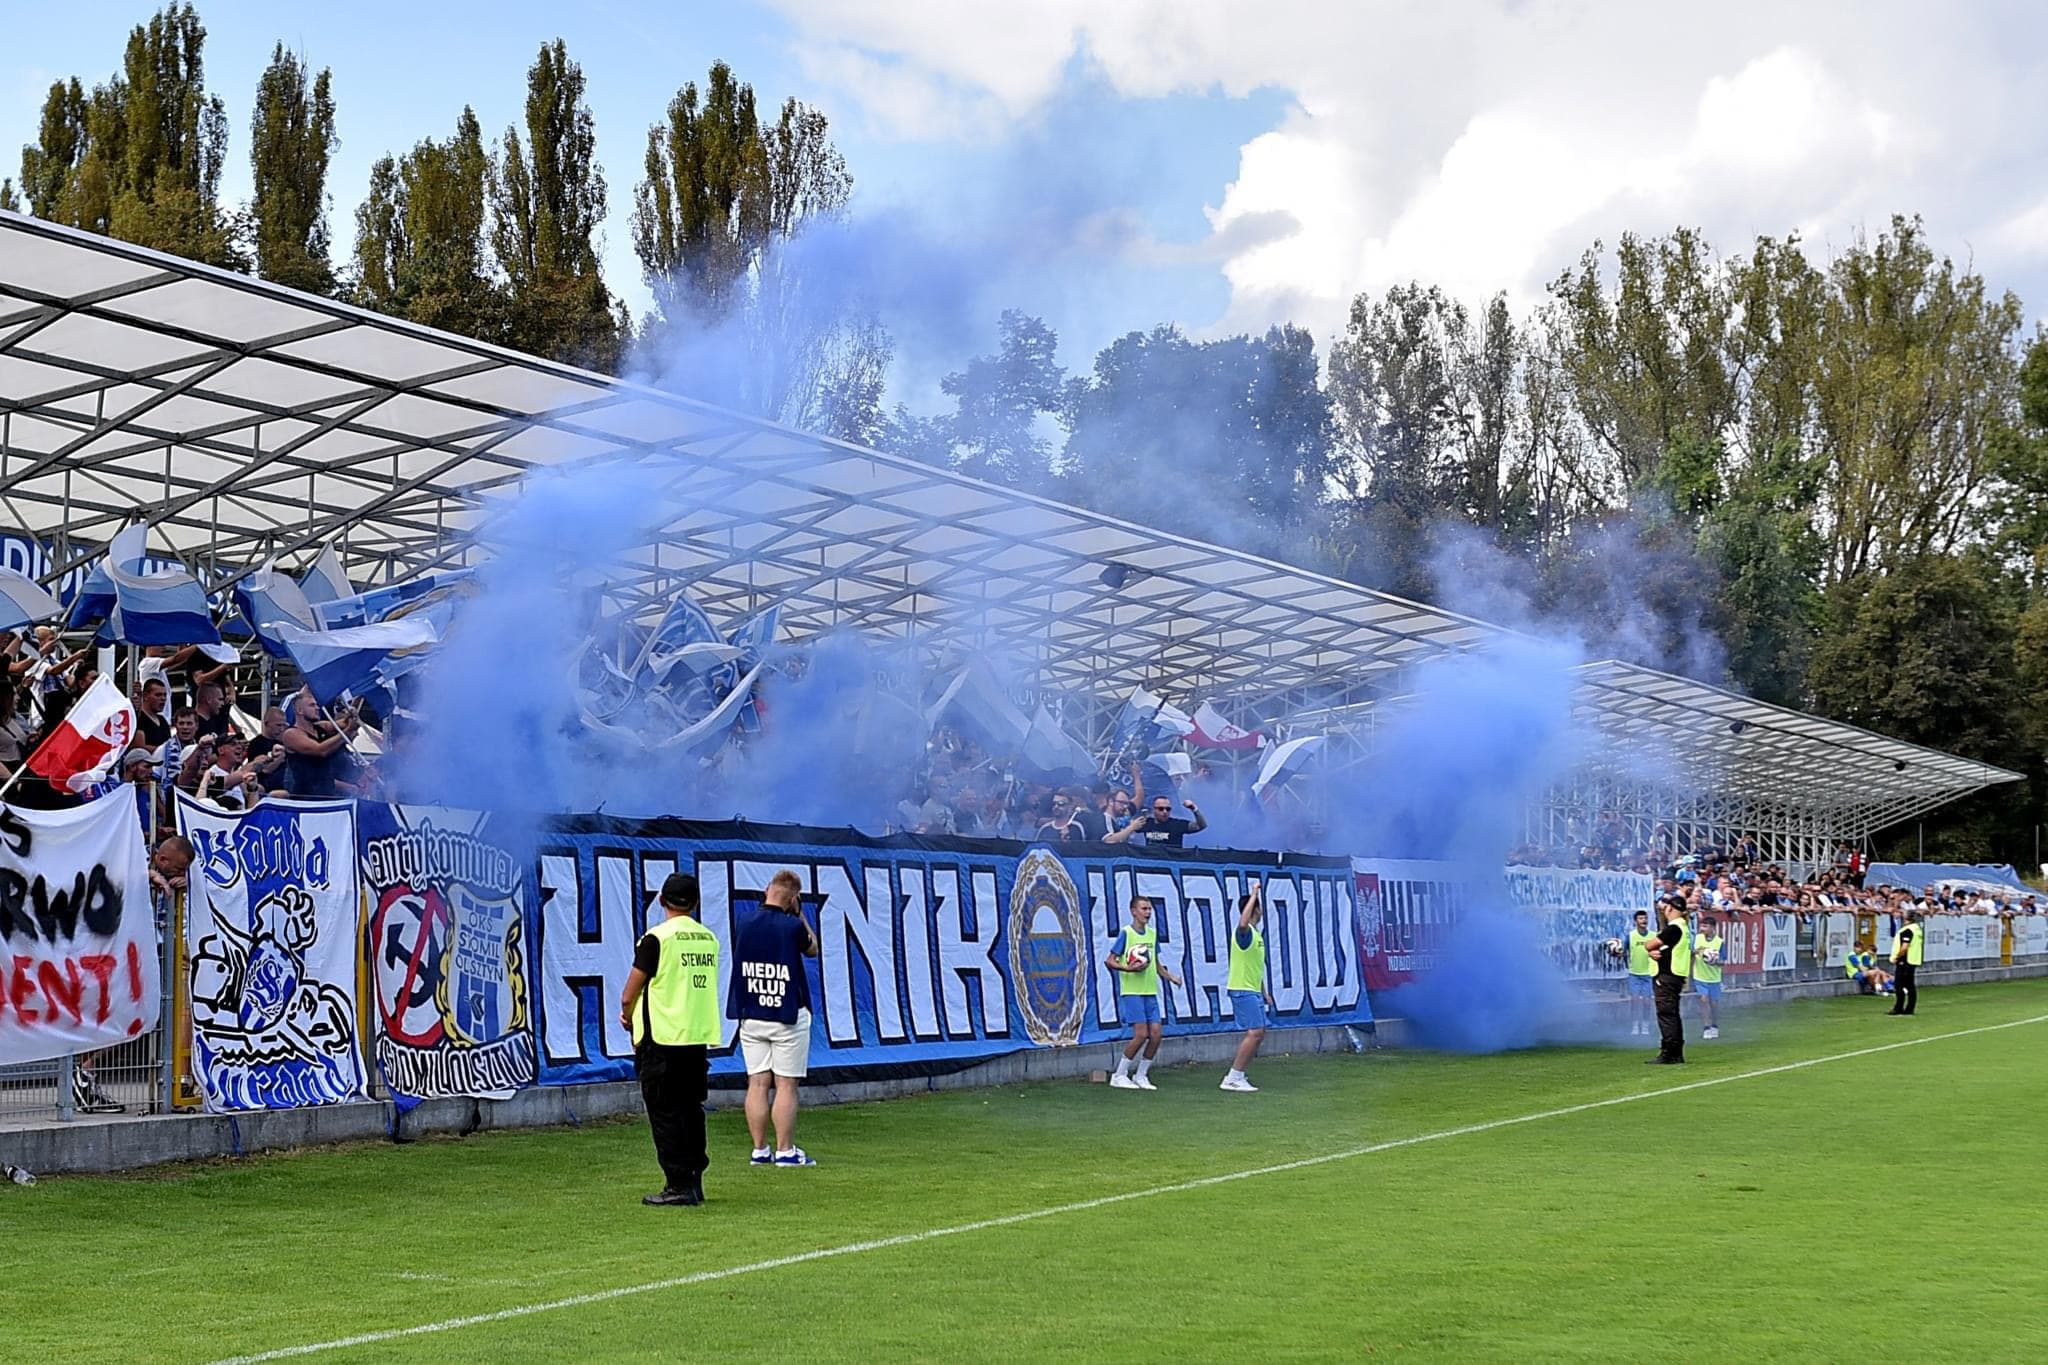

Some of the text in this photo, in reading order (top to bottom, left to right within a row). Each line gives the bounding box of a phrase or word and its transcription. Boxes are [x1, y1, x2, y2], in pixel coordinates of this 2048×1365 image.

[192, 816, 330, 889] Banda
[367, 816, 514, 894] antykomuna
[469, 911, 493, 932] OKS
[455, 954, 503, 982] OLSZTYN
[681, 953, 715, 967] STEWAR
[742, 961, 790, 981] MEDIA
[693, 974, 707, 989] 022
[747, 978, 786, 996] KLUB
[758, 995, 782, 1007] 005
[382, 1030, 535, 1098] STOMIL OLSZTYN
